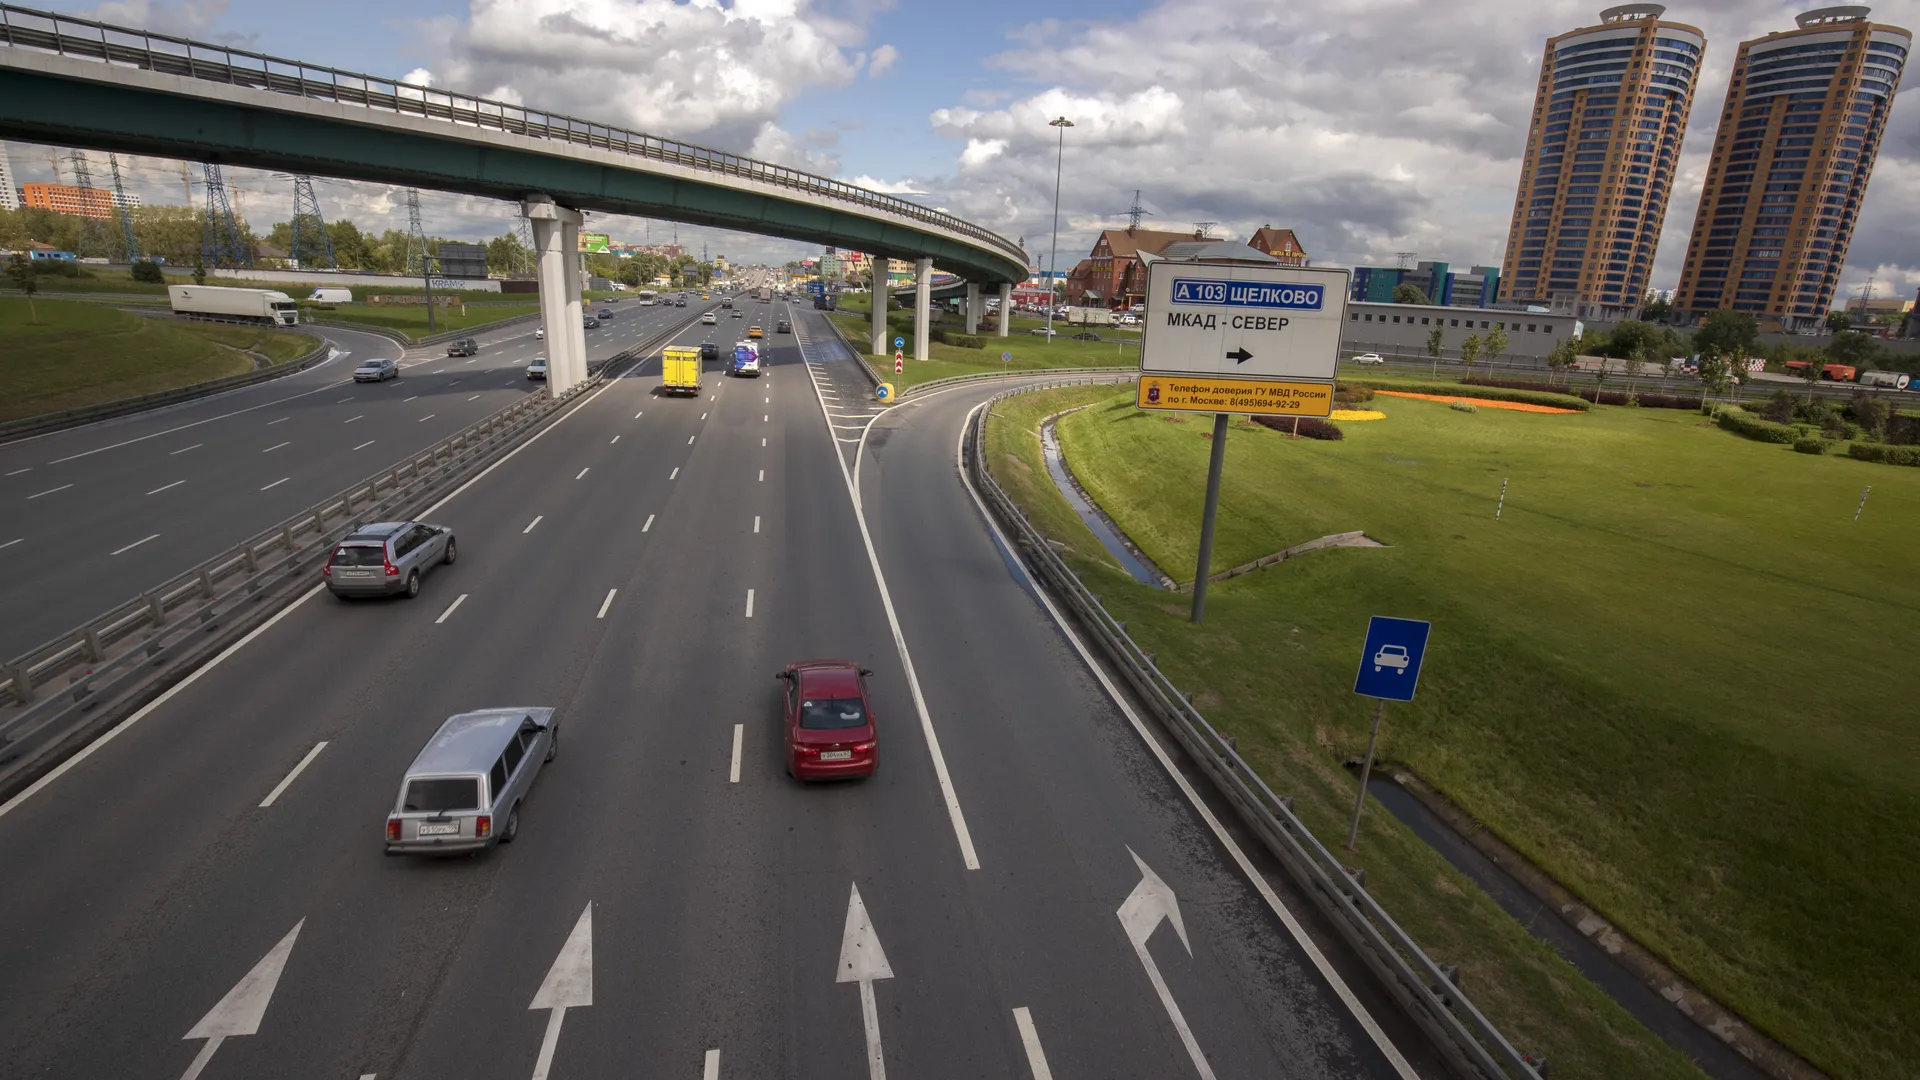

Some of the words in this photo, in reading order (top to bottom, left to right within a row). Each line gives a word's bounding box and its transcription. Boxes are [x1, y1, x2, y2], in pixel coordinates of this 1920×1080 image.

[1176, 284, 1190, 299] А
[1195, 285, 1224, 300] 103
[1230, 286, 1319, 305] ЩЕЛКОВО
[1167, 312, 1216, 330] МКАД
[1232, 315, 1289, 331] СЕВЕР
[1169, 383, 1210, 394] Телефон
[1212, 386, 1253, 396] доверия
[1255, 387, 1267, 396] ГУ
[1268, 388, 1290, 398] МВД
[1292, 389, 1326, 399] России
[1189, 396, 1227, 406] Москве:
[1229, 397, 1300, 409] 8(495)694-92-29
